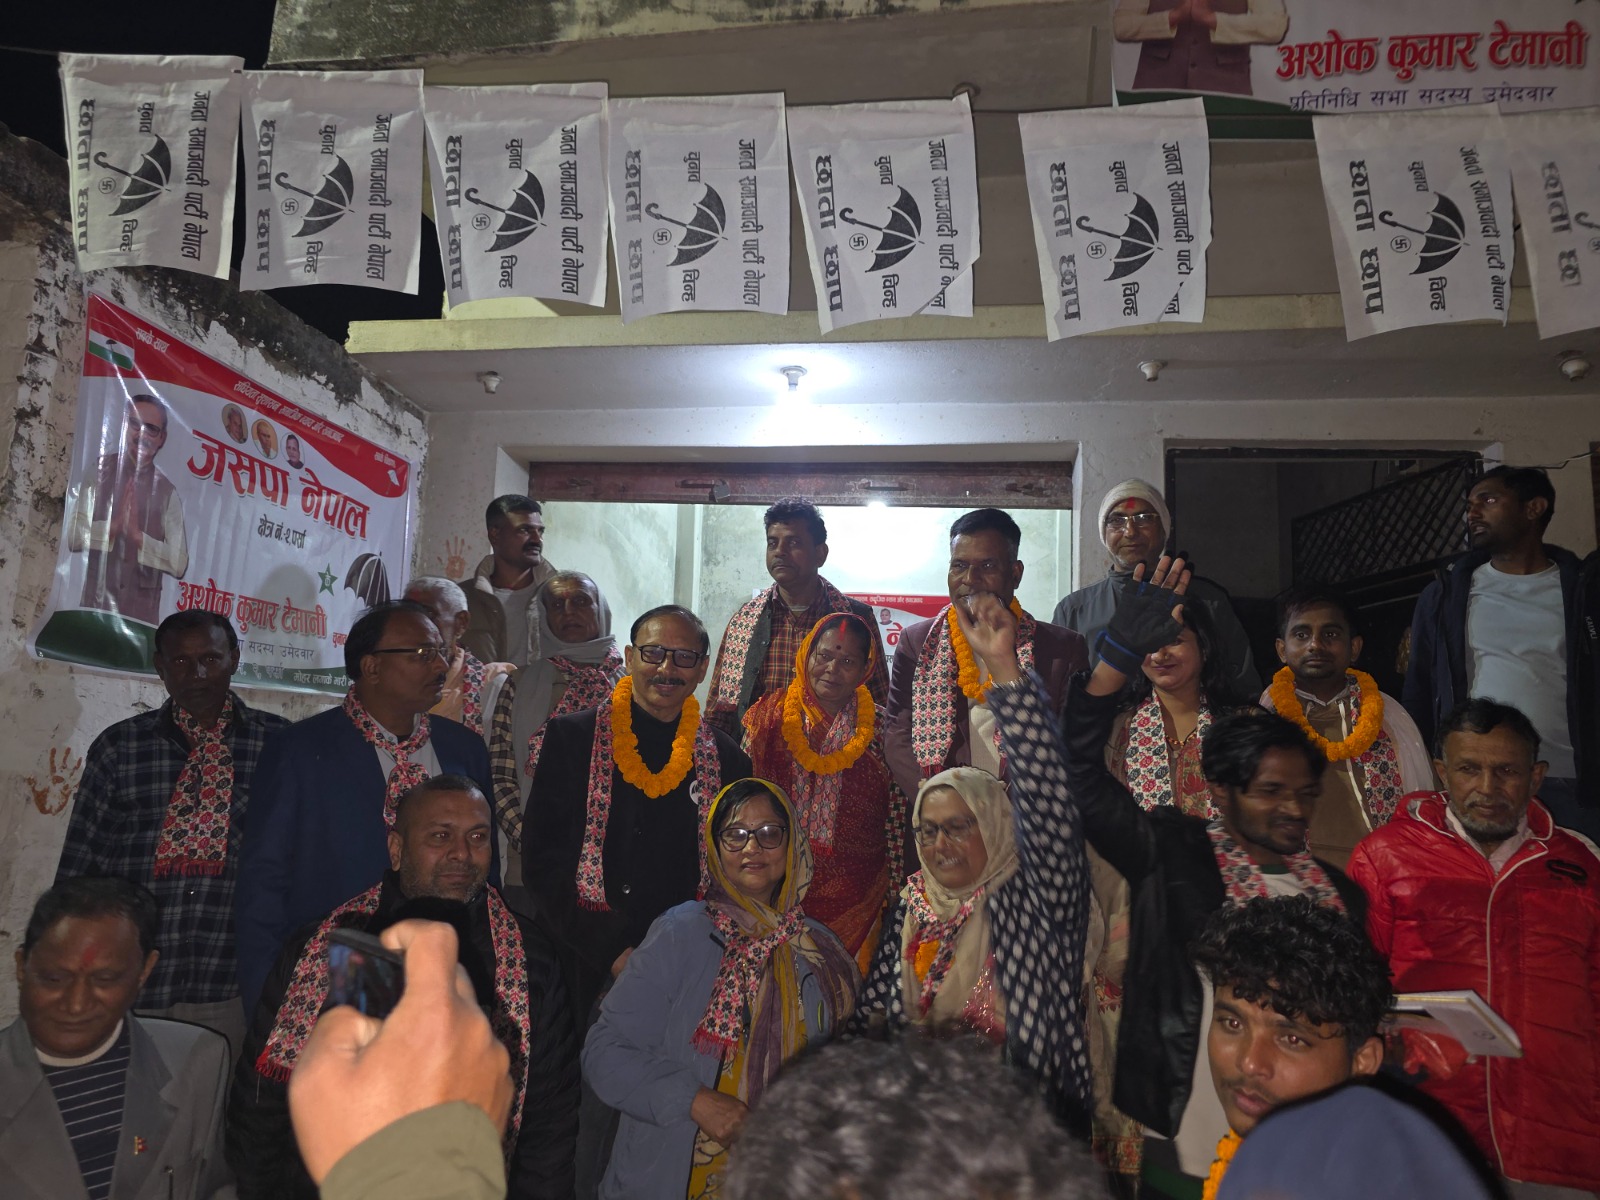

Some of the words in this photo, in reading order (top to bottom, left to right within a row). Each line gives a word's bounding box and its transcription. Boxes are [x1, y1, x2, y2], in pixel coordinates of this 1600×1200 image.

[1276, 29, 1383, 82] अशोक
[1387, 31, 1487, 83] कुमार
[1488, 20, 1590, 71] टेमानी
[137, 102, 154, 133] चुनाव
[192, 91, 211, 121] जनता
[1290, 86, 1361, 112] प्रतिनिधि
[1370, 89, 1409, 107] सभा
[1418, 87, 1473, 104] सदस्य
[1482, 85, 1558, 102] उमेदवार
[78, 99, 95, 171] छाता
[319, 124, 336, 155] चुनाव
[372, 114, 392, 142] जनता
[560, 125, 577, 155] जनता
[186, 127, 209, 187] समाजवादी
[257, 120, 276, 192] छाता
[446, 135, 462, 208] छाता
[506, 138, 522, 169] चुनाव
[684, 151, 700, 183] चुनाव
[874, 155, 893, 186] चुनाव
[1162, 141, 1183, 175] जनता
[1459, 145, 1484, 175] जनता
[368, 148, 392, 207] समाजवादी
[559, 160, 583, 221] समाजवादी
[625, 149, 642, 223] छाता
[815, 155, 836, 229] छाता
[1349, 160, 1375, 231] छाता
[184, 192, 208, 220] पार्टी
[739, 176, 763, 233] समाजवादी
[928, 139, 947, 171] जनता
[939, 243, 958, 271] पार्टी
[1049, 162, 1073, 237] छाता
[1167, 181, 1193, 243] समाजवादी
[1470, 180, 1500, 238] समाजवादी
[1542, 161, 1572, 234] छाता
[78, 188, 89, 253] छाप
[120, 219, 138, 252] चिन्ह
[368, 213, 391, 238] पार्टी
[1109, 160, 1129, 193] चुनाव
[1122, 282, 1139, 316] चिन्ह
[1408, 161, 1429, 192] चुनाव
[1429, 277, 1447, 311] चिन्ह
[181, 223, 208, 261] नेपाल
[257, 208, 270, 273] छाप
[304, 241, 322, 274] चिन्ह
[448, 224, 462, 290] छाप
[561, 227, 583, 253] पार्टी
[742, 238, 764, 264] पार्टी
[1485, 244, 1505, 270] पार्टी
[367, 244, 391, 281] नेपाल
[499, 255, 517, 288] चिन्ह
[561, 258, 584, 296] नेपाल
[629, 238, 644, 304] छाप
[824, 245, 843, 311] छाप
[1360, 247, 1384, 314] छाप
[682, 269, 699, 302] चिन्ह
[743, 270, 765, 306] नेपाल
[881, 274, 899, 308] चिन्ह
[1058, 254, 1081, 321] छाप
[1491, 275, 1506, 311] नेपाल
[186, 429, 292, 511] जसपा
[298, 467, 371, 541] नेपाल
[257, 513, 274, 539] क्षेत्र
[236, 594, 280, 633] कुमार
[281, 596, 327, 638] टेमानी
[249, 640, 275, 656] सदस्य
[280, 642, 315, 661] उमेदवार
